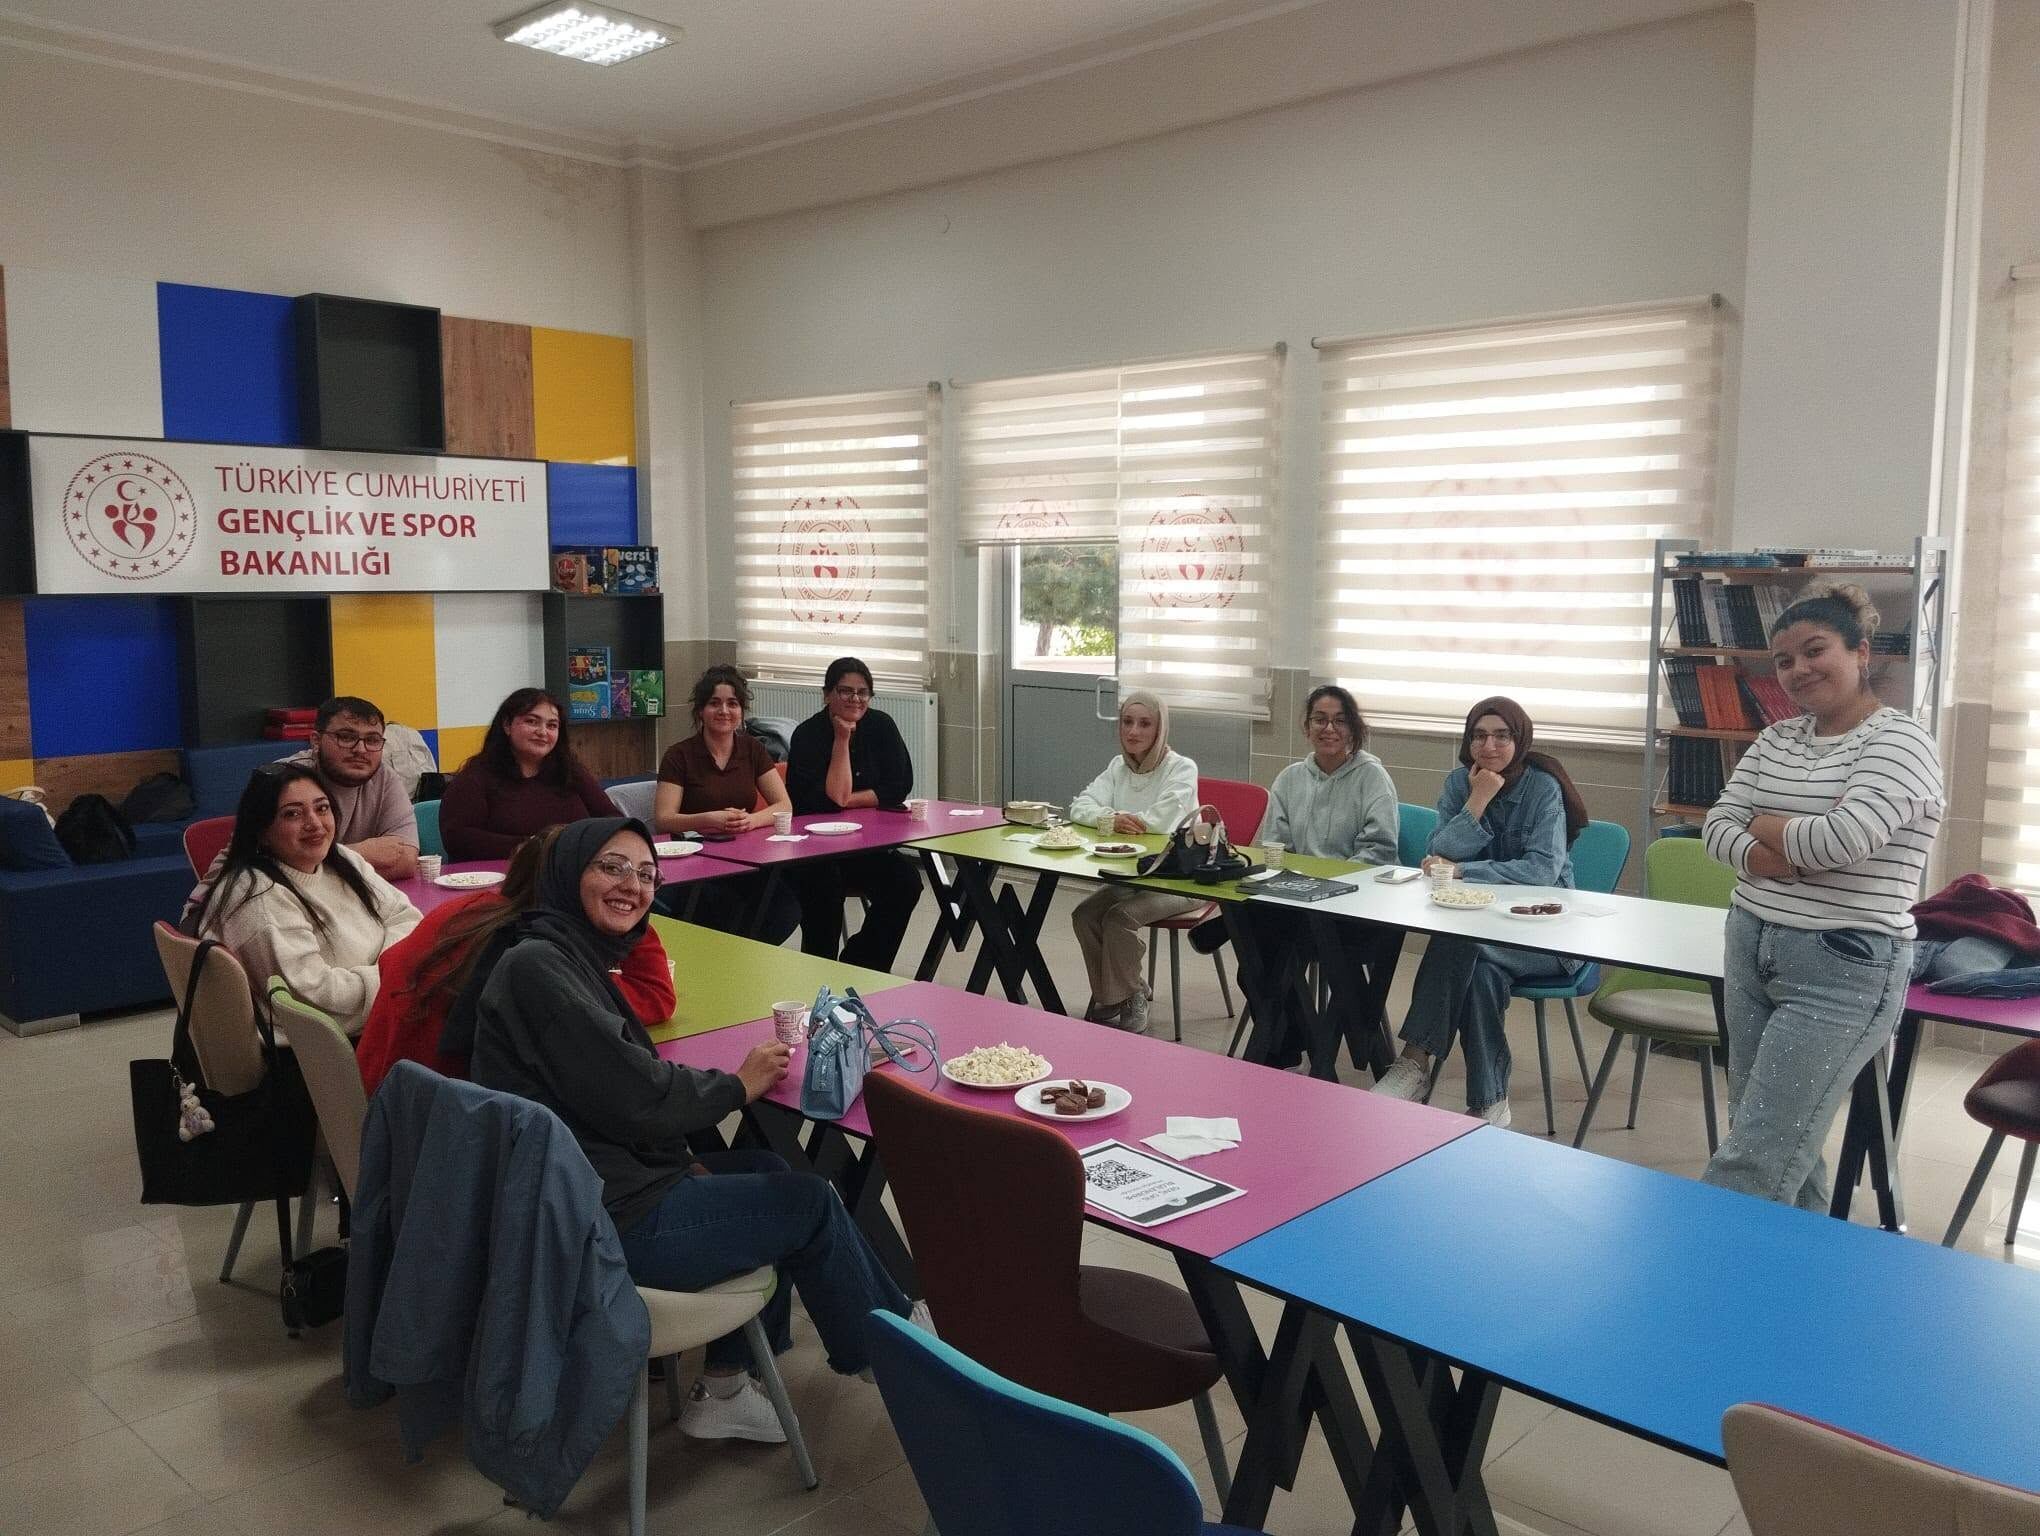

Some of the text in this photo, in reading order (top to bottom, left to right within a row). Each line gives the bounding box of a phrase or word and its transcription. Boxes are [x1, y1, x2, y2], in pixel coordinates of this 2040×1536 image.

[214, 462, 526, 503] TÜRKİYE CUMHURİYETİ
[217, 505, 477, 542] GENÇLİK VE SPOR
[219, 546, 391, 576] BAKANLIĞI
